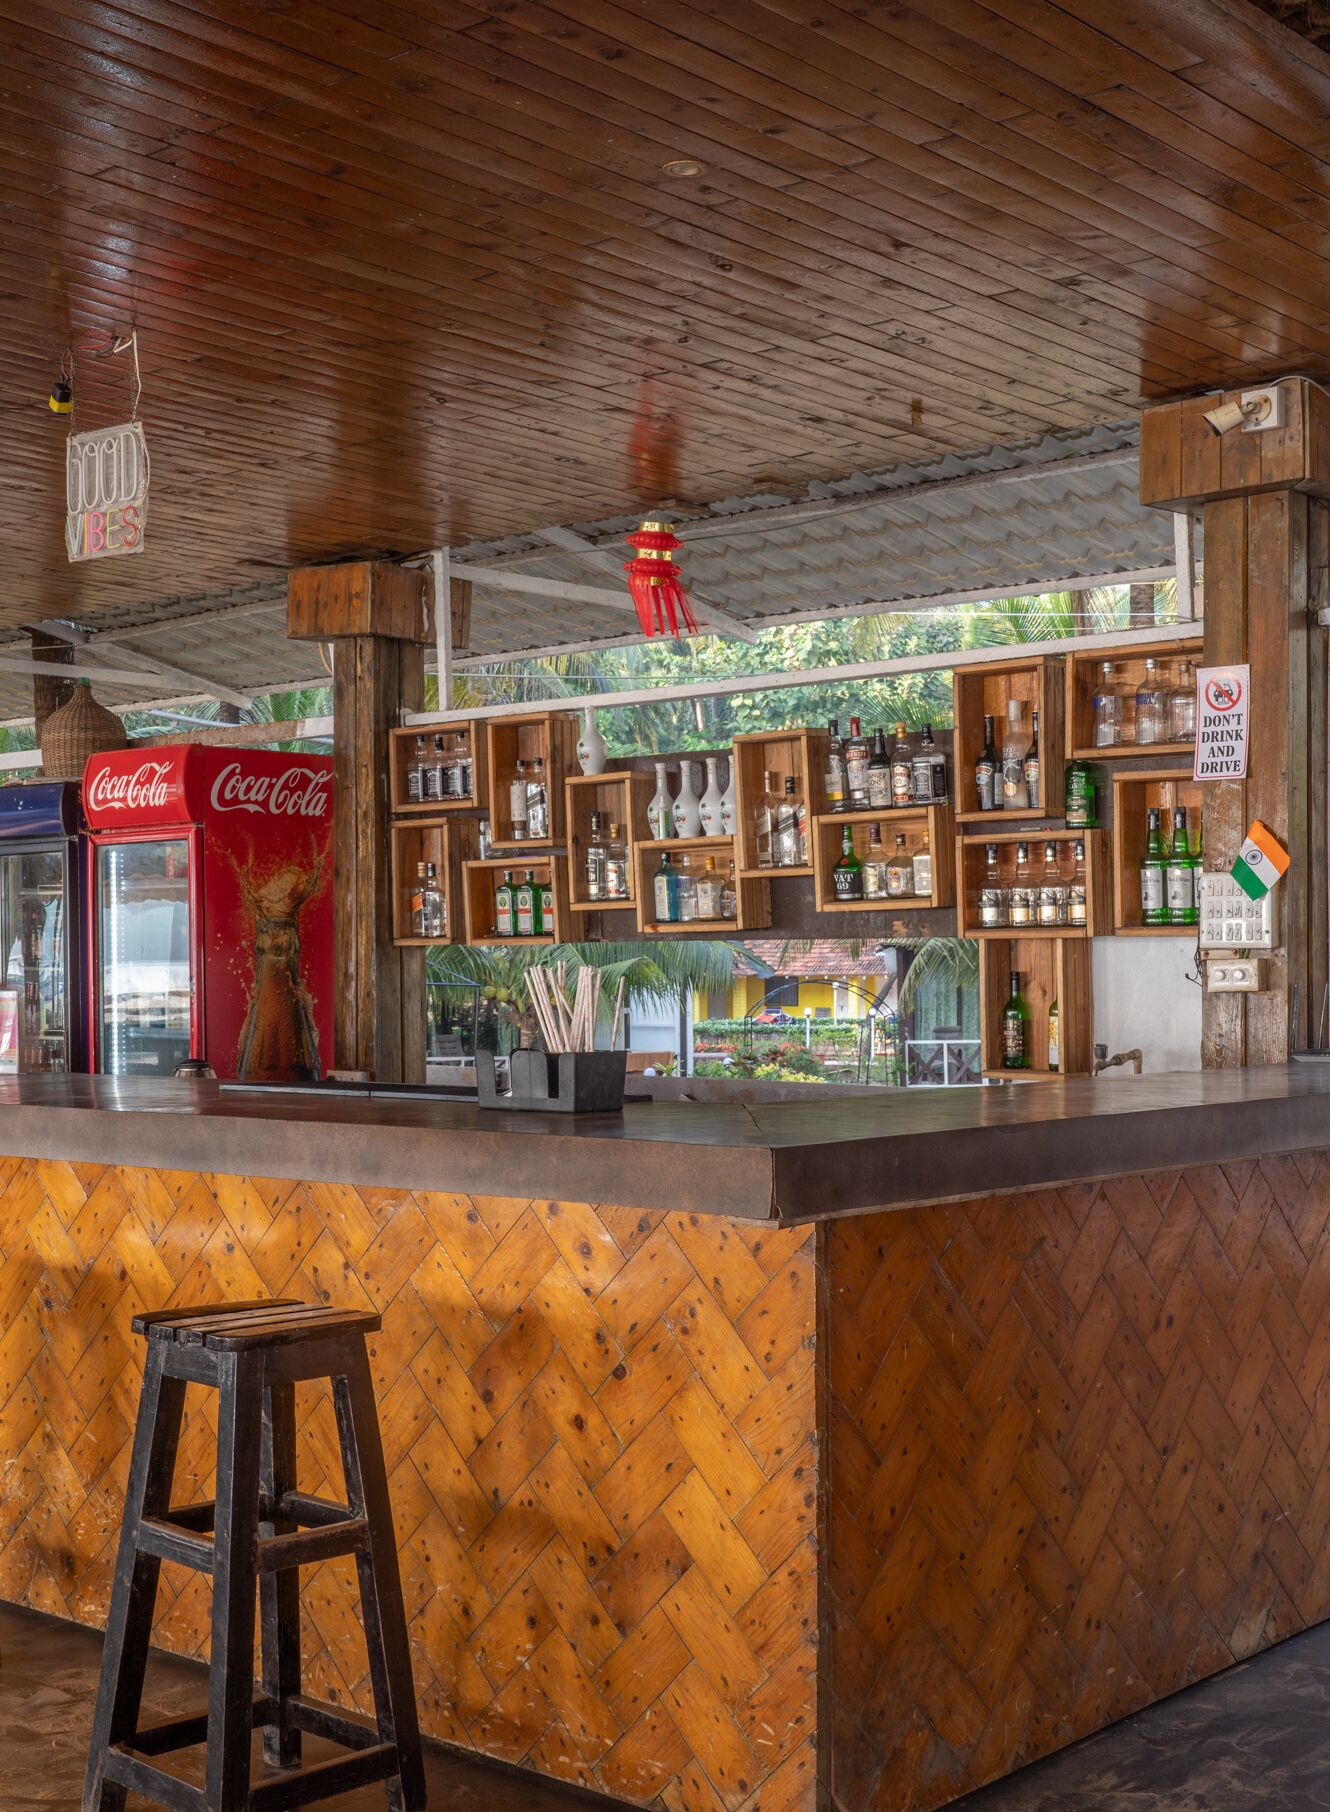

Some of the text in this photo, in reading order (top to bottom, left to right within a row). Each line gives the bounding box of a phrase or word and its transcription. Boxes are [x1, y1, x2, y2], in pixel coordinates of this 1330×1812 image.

[66, 432, 138, 515] GOOD
[66, 505, 139, 555] VIBES
[1203, 713, 1243, 728] DON'T
[1201, 729, 1244, 743] DRINK
[1207, 745, 1235, 758] AND
[1200, 760, 1241, 774] DRIVE
[89, 760, 175, 812] Coca-Cola
[210, 762, 335, 817] Coca-Cola
[833, 873, 854, 882] VAT
[836, 882, 849, 890] 69
